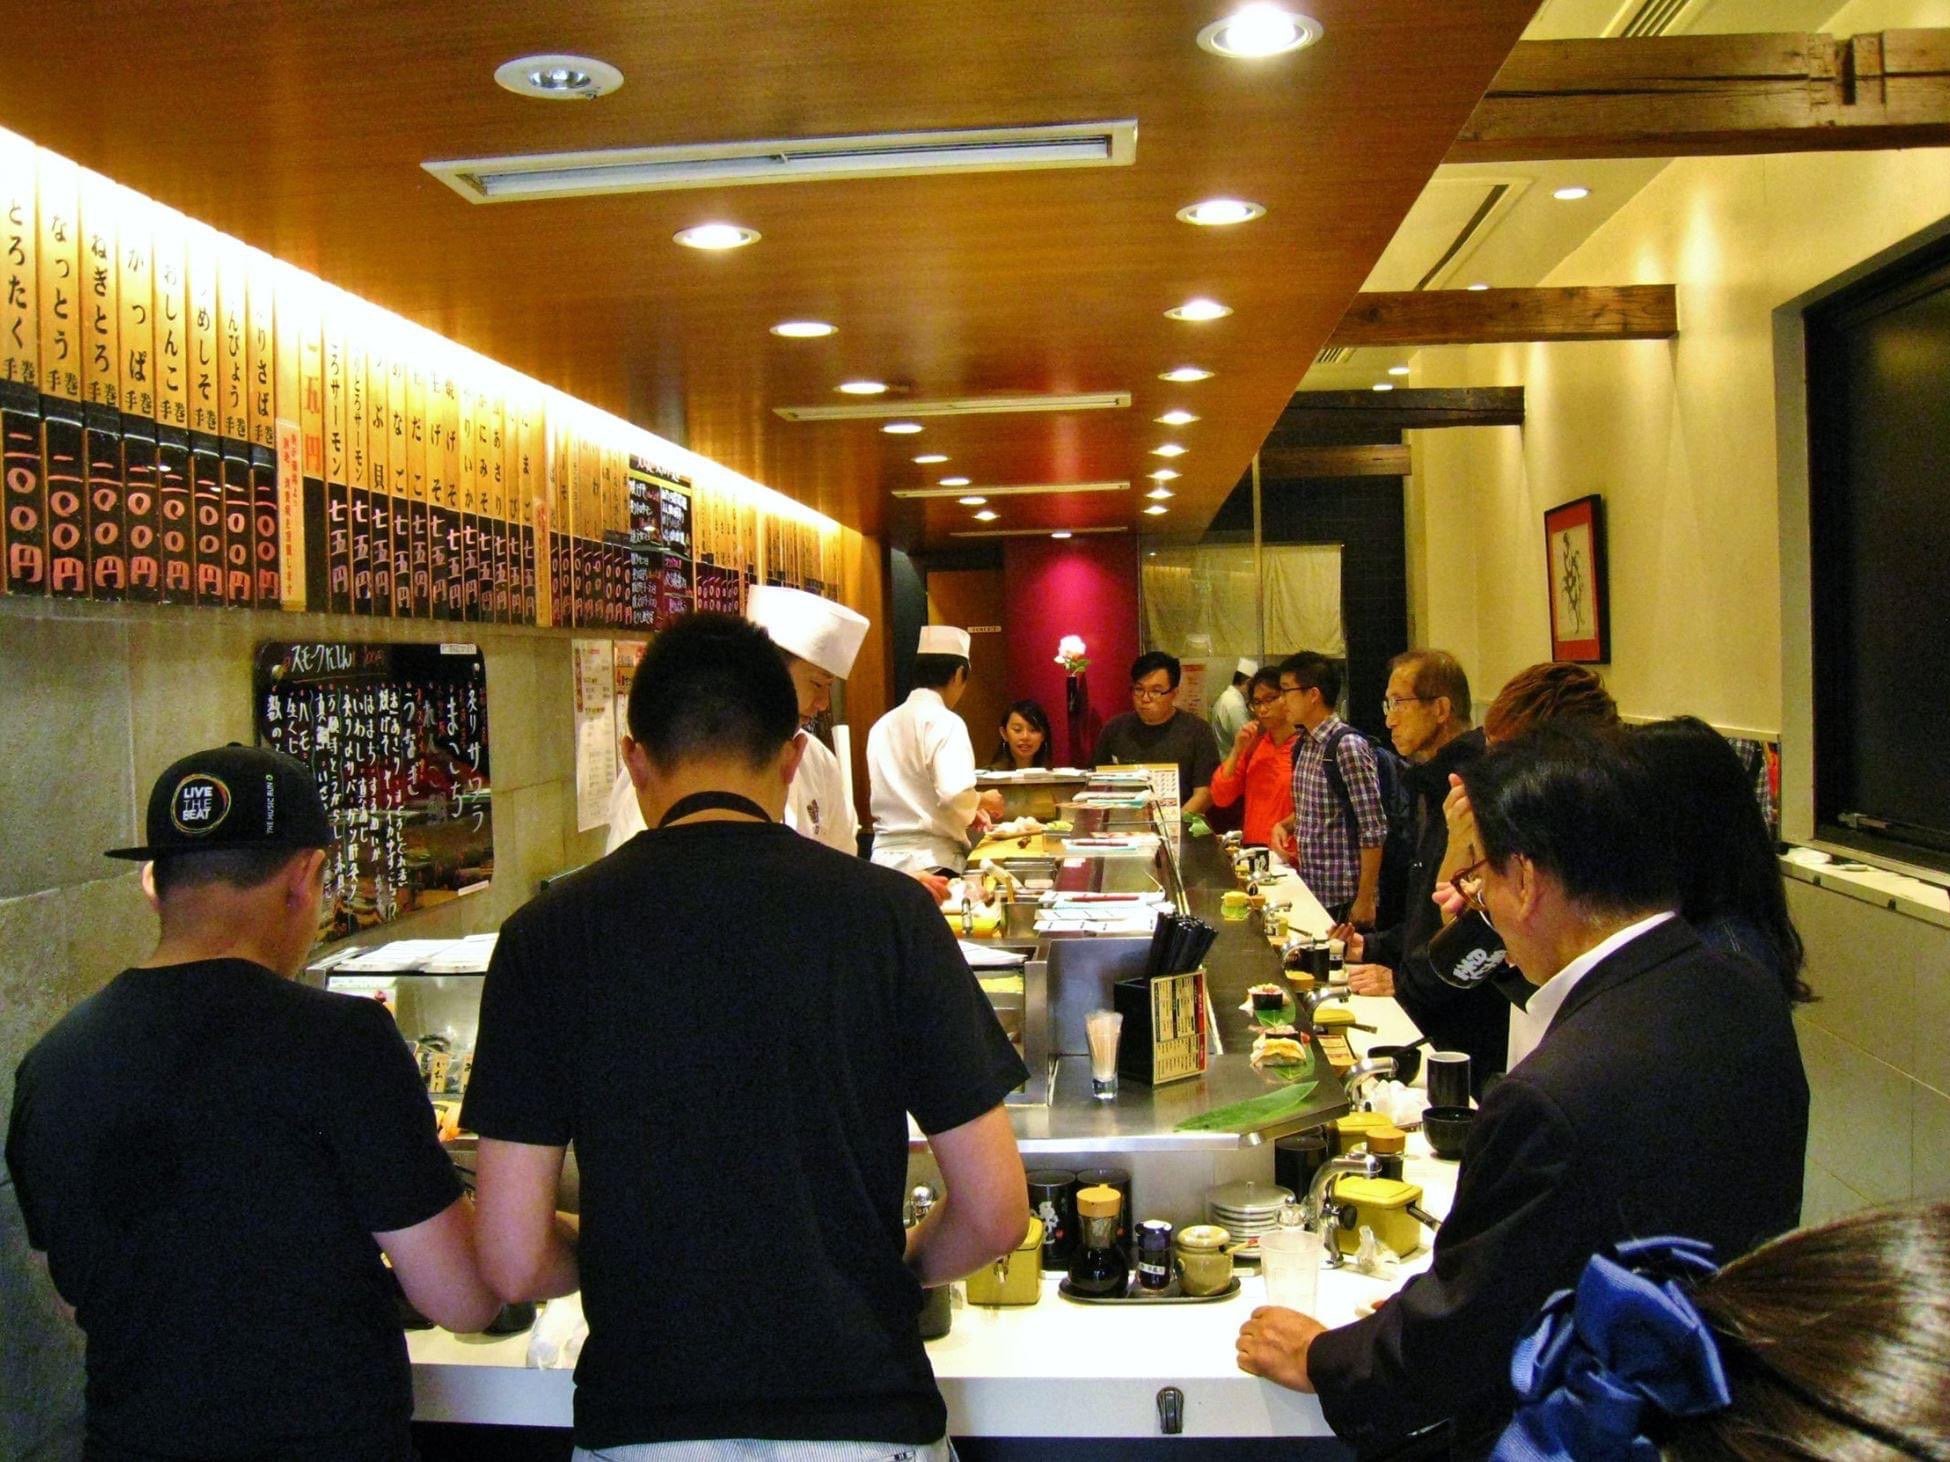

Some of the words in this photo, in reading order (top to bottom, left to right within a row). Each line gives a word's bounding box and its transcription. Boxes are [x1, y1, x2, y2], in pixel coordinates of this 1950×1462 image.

[331, 343, 342, 477] ろサーモン
[184, 786, 213, 798] LIVE
[184, 798, 212, 810] THE
[182, 808, 212, 821] BEAT
